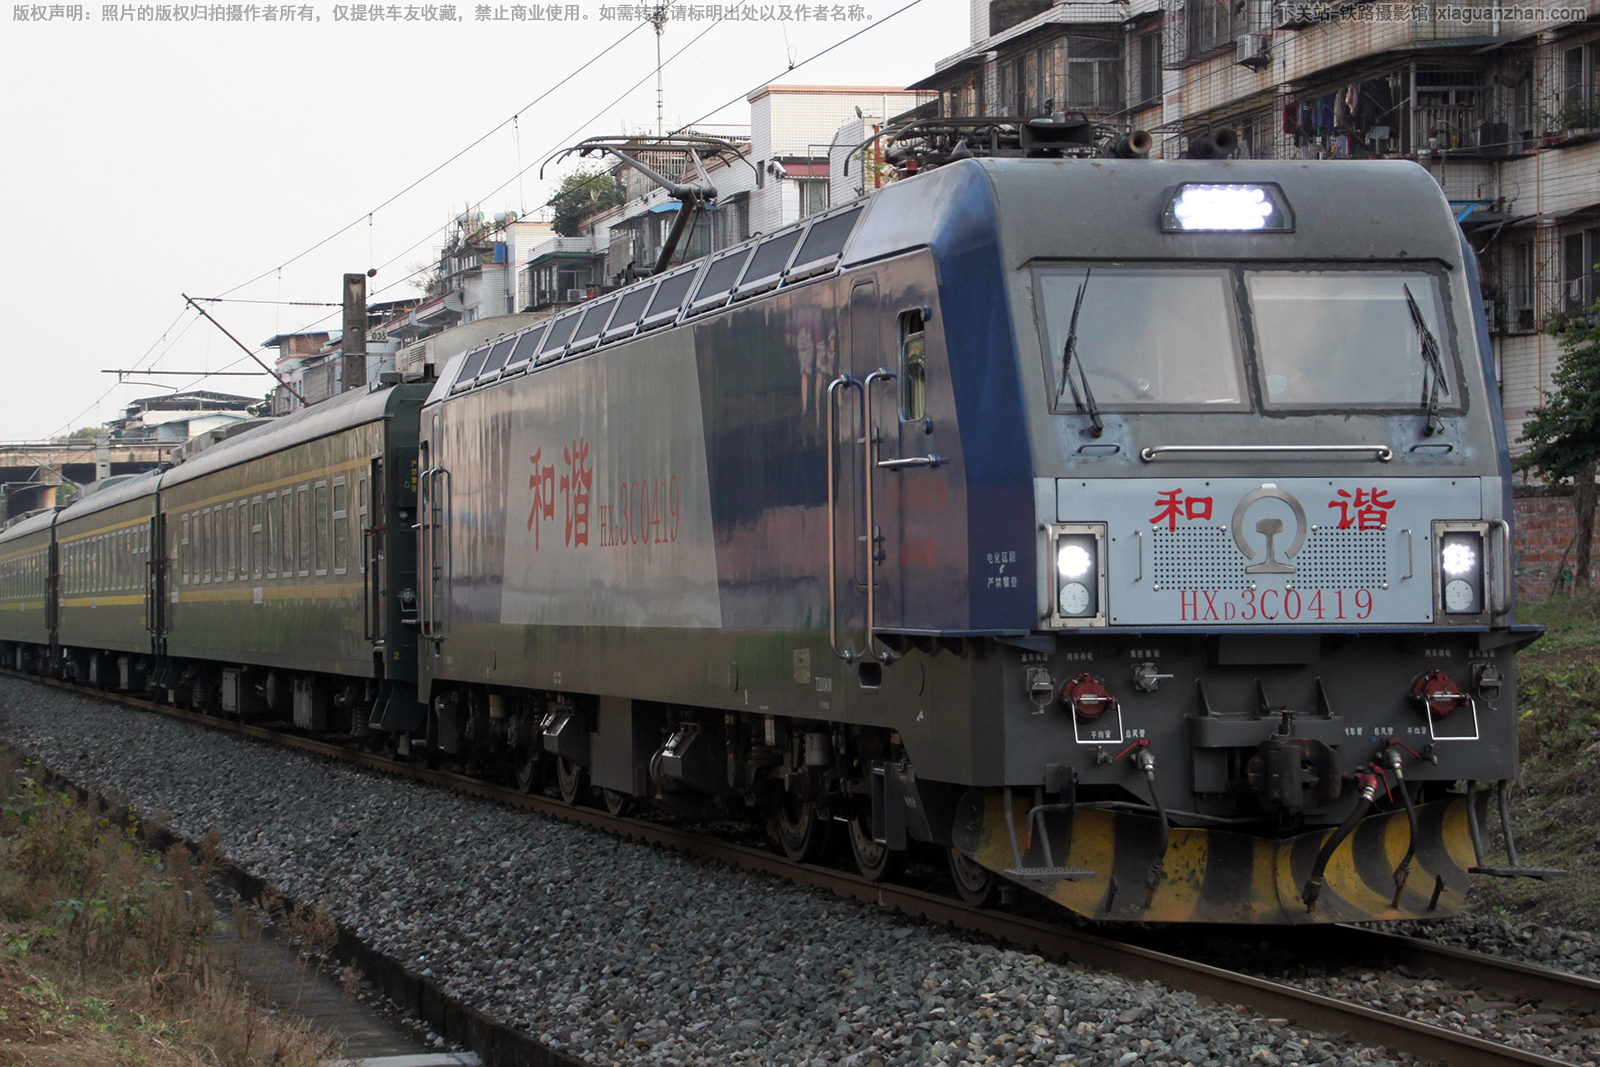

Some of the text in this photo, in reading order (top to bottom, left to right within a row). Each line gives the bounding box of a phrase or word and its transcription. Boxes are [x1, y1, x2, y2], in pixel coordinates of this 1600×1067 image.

[371, 332, 387, 340] 035
[527, 436, 593, 551] 和谐
[986, 551, 1017, 564] 电化区段
[987, 576, 1018, 589] 严禁攀登
[393, 651, 400, 660] 2
[1090, 730, 1112, 740] 平均管
[1125, 729, 1146, 739] 总风管
[1374, 727, 1394, 737] 总风管
